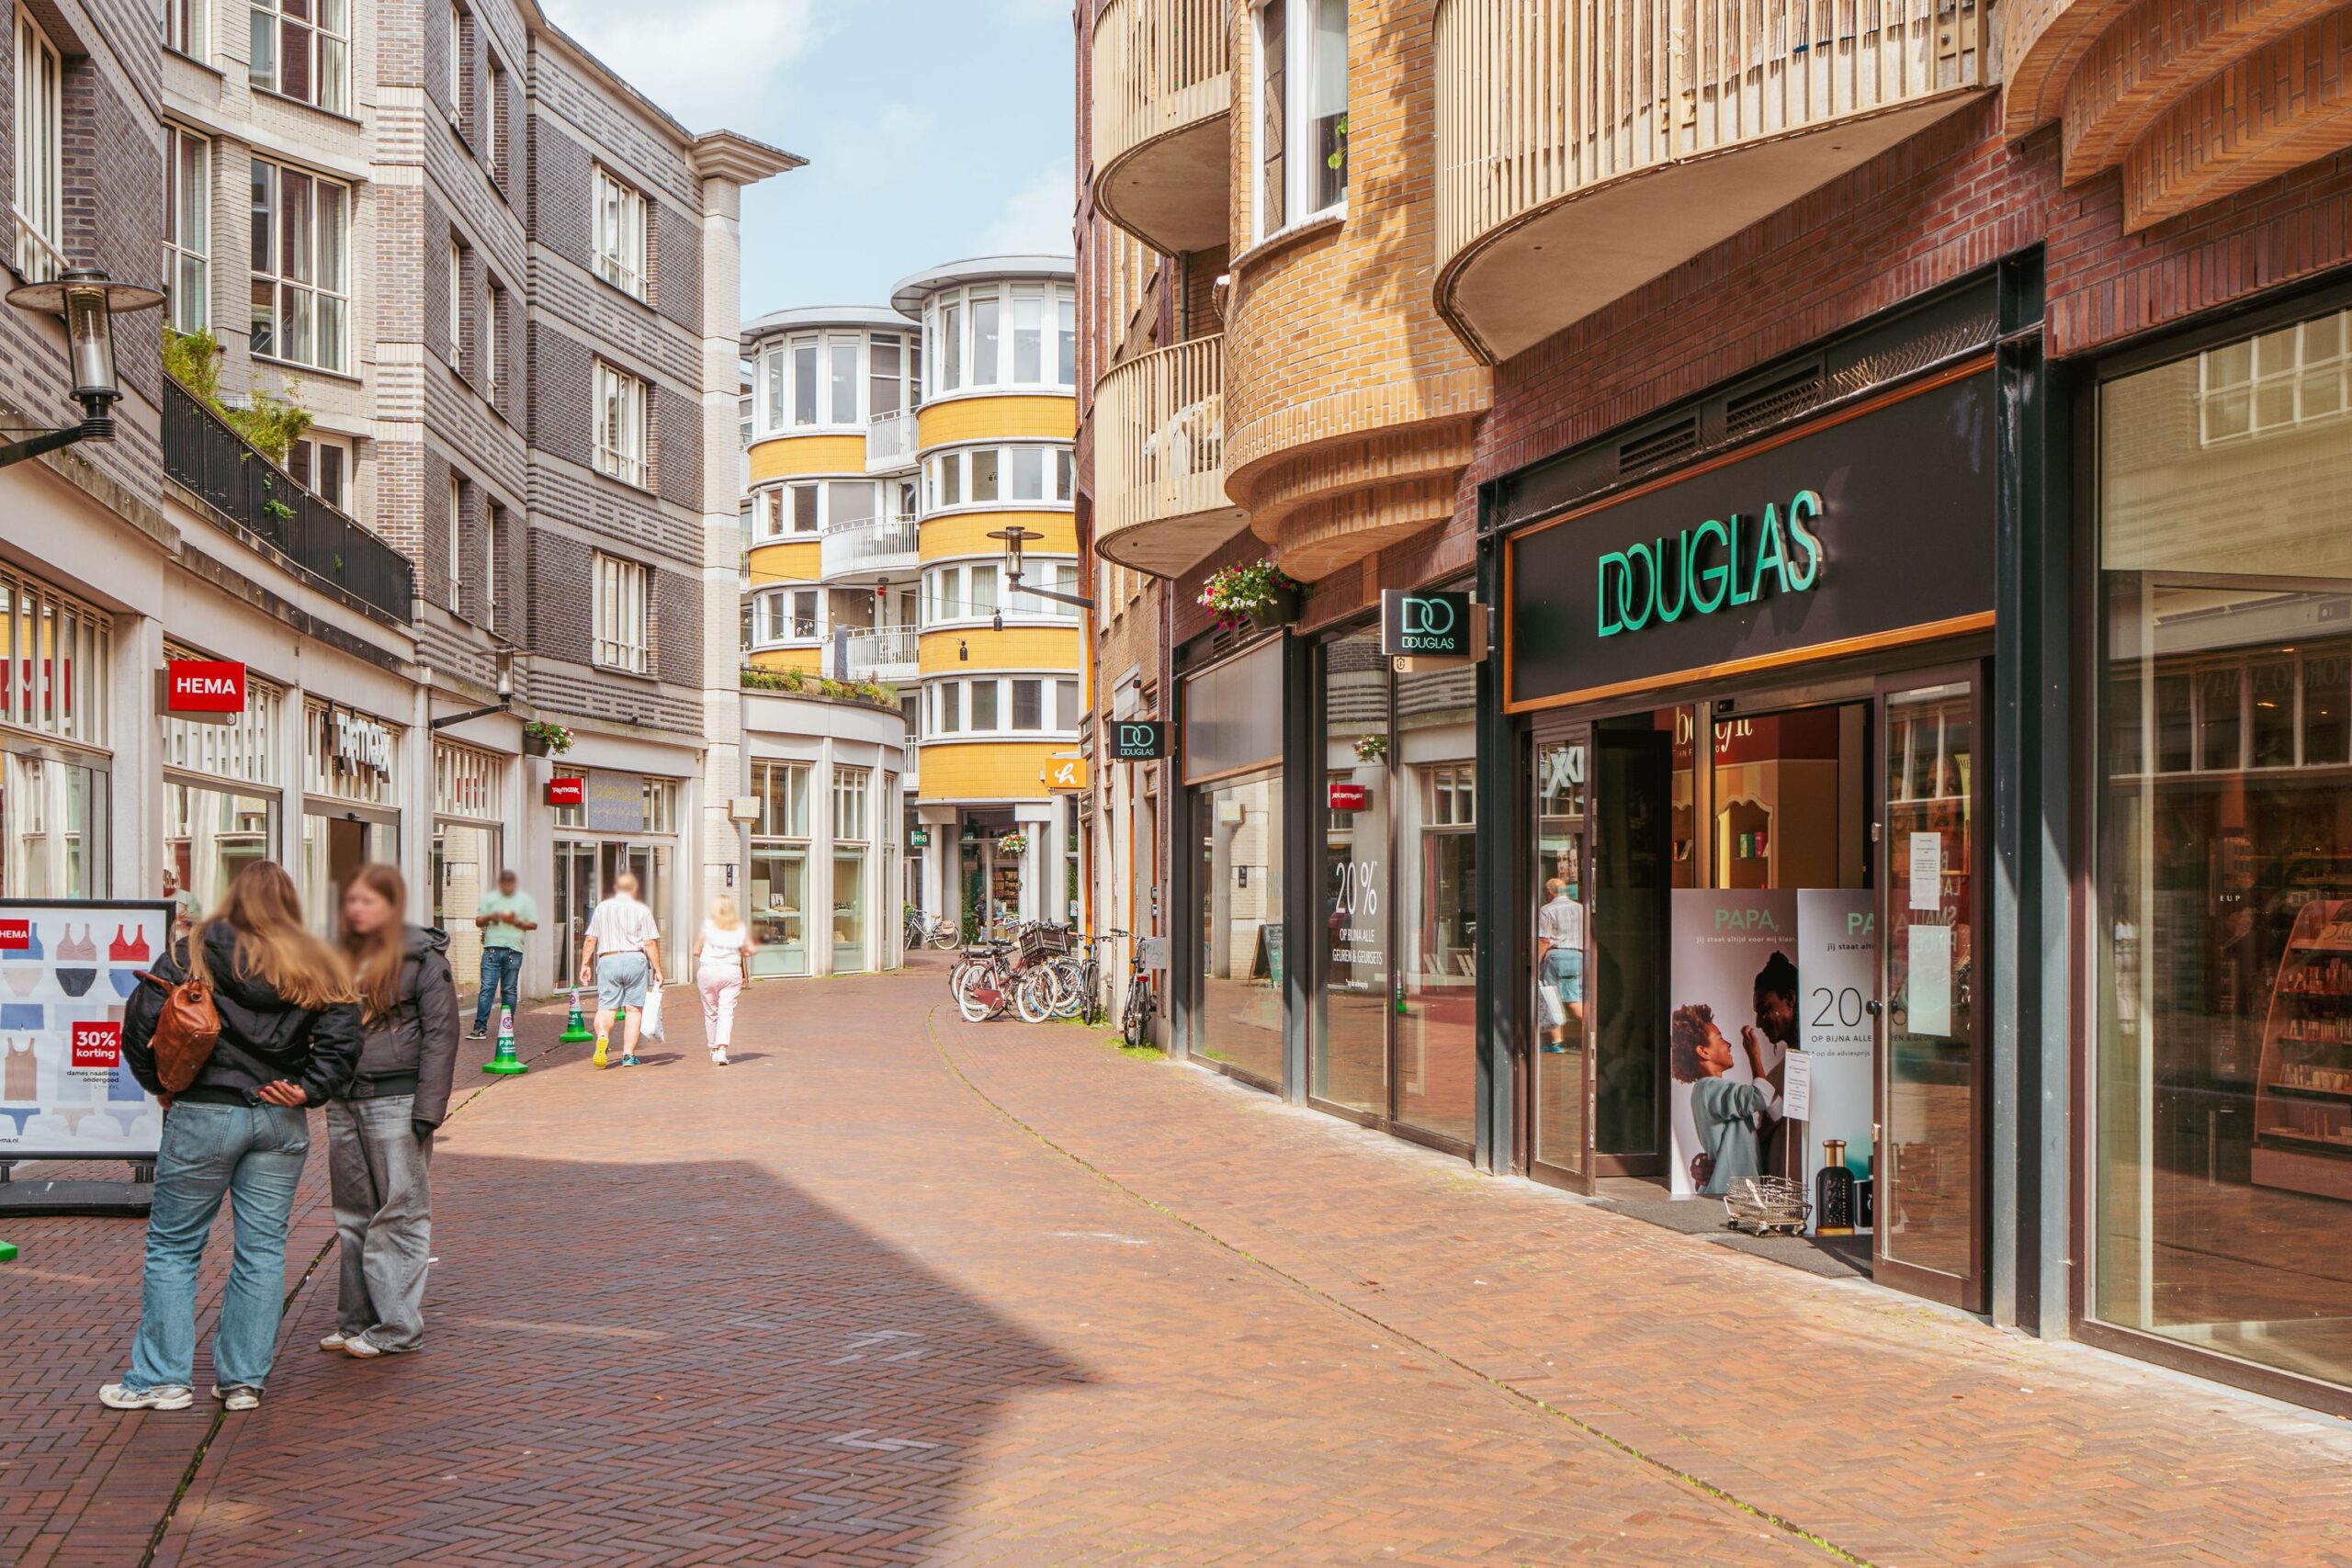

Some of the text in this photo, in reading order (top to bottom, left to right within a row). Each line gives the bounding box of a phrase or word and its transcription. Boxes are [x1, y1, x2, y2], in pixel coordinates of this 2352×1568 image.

[1598, 490, 1824, 638] DOUGLAS
[1401, 637, 1454, 649] DOUGLAS
[176, 677, 236, 694] HEMA
[1120, 748, 1155, 756] DOUGLAS
[1714, 908, 1780, 932] PAPA,
[0, 930, 28, 939] HEMA
[1340, 928, 1348, 942] OP
[1363, 930, 1375, 942] ALLE
[1727, 935, 1746, 943] altijd
[1766, 935, 1777, 943] mij
[1826, 942, 1836, 952] jij
[1838, 942, 1859, 951] staat
[1332, 949, 1352, 963] GEUREN
[1357, 951, 1383, 965] GEURSETS
[76, 1032, 117, 1046] 30%
[76, 1048, 116, 1060] korting
